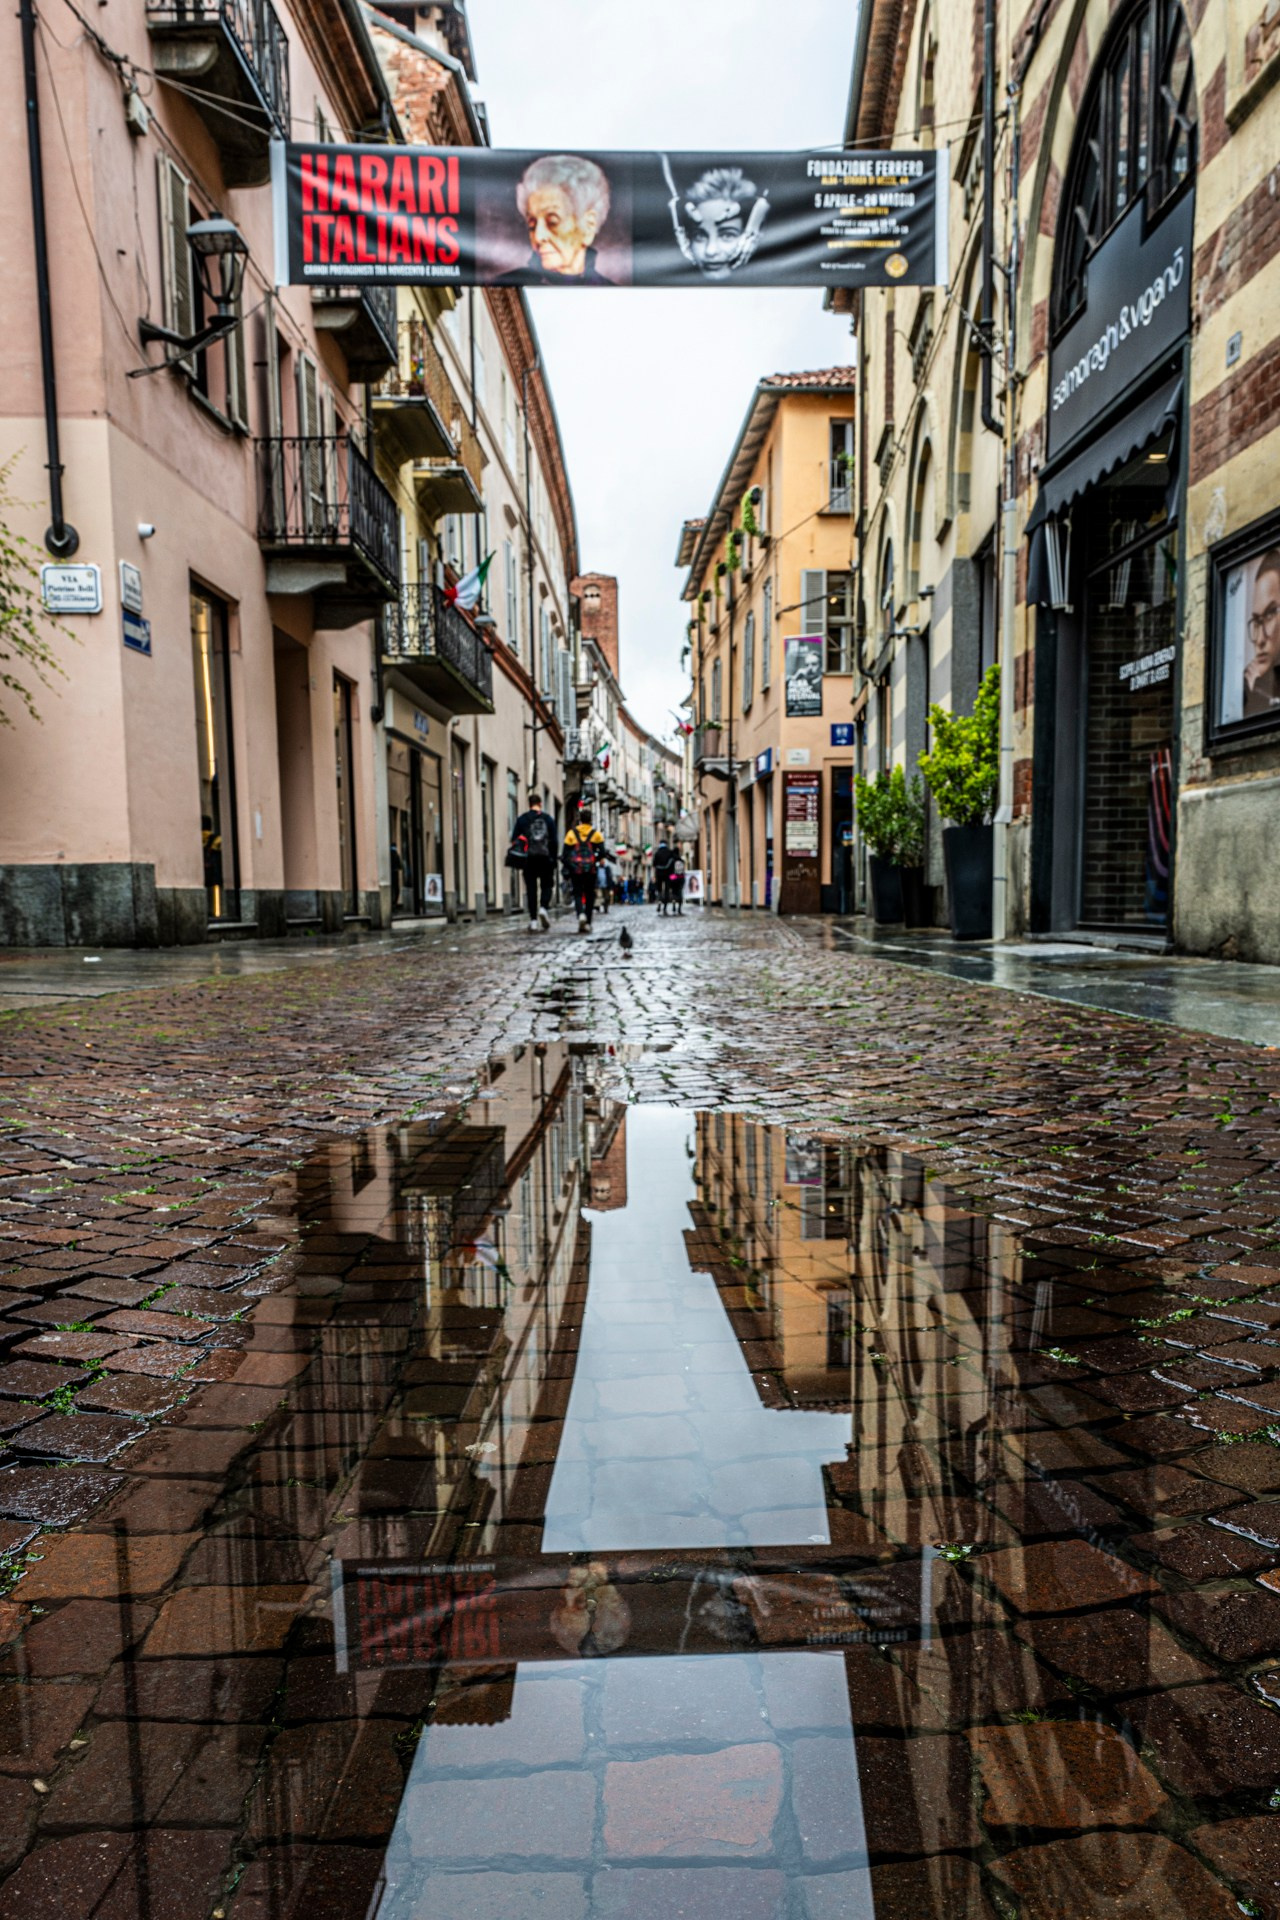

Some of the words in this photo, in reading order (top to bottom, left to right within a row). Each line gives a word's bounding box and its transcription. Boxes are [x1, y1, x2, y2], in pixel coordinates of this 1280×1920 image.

[807, 160, 874, 177] FONDAZIONE
[875, 159, 924, 177] FERRERO
[301, 153, 460, 214] HARARI
[823, 193, 857, 208] APRILE
[878, 192, 915, 207] MAGGIO
[302, 214, 460, 264] ITALIANS
[61, 575, 78, 583] VIA
